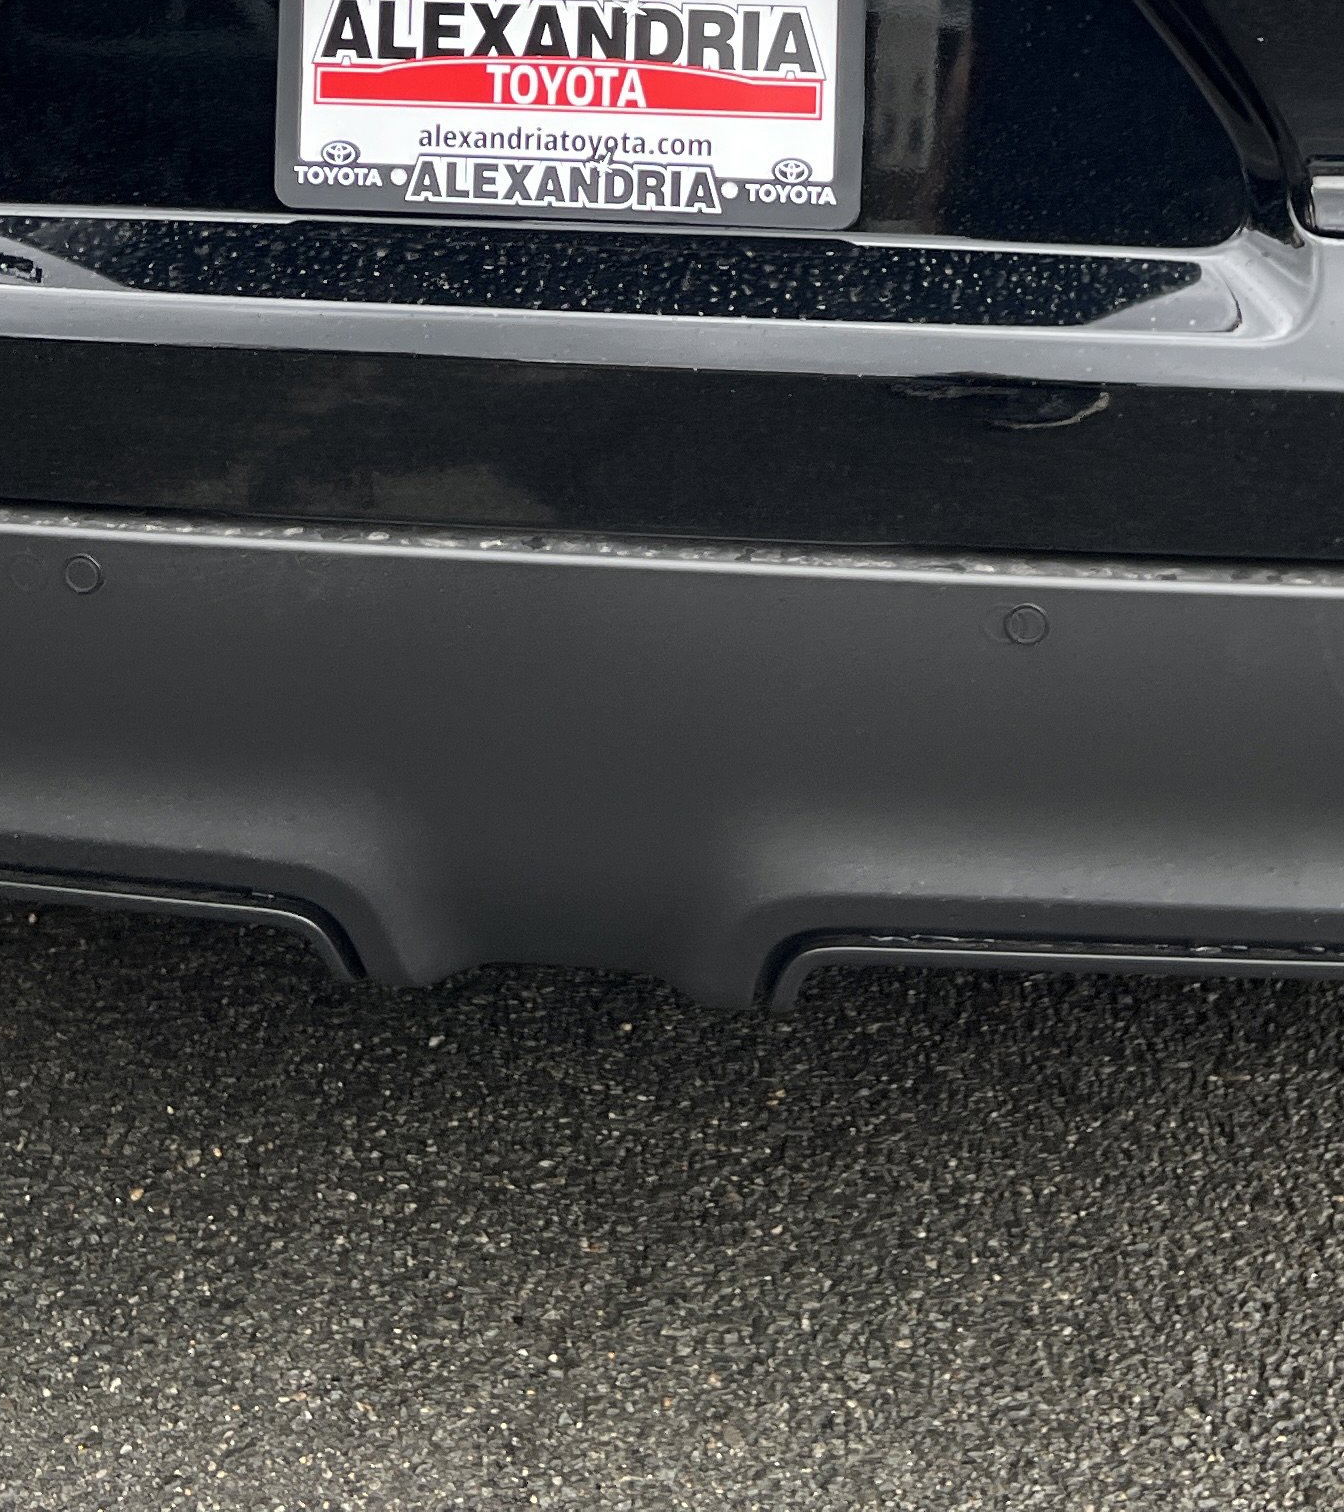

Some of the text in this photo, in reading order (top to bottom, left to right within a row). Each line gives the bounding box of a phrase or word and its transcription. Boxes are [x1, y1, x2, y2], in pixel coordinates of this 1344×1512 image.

[486, 63, 647, 109] TOYOTA
[418, 125, 713, 158] alexandriatoyota.com
[293, 165, 382, 187] TOYOTA
[407, 158, 719, 211] ALEXANDRIA
[745, 183, 837, 206] TOYOTA
